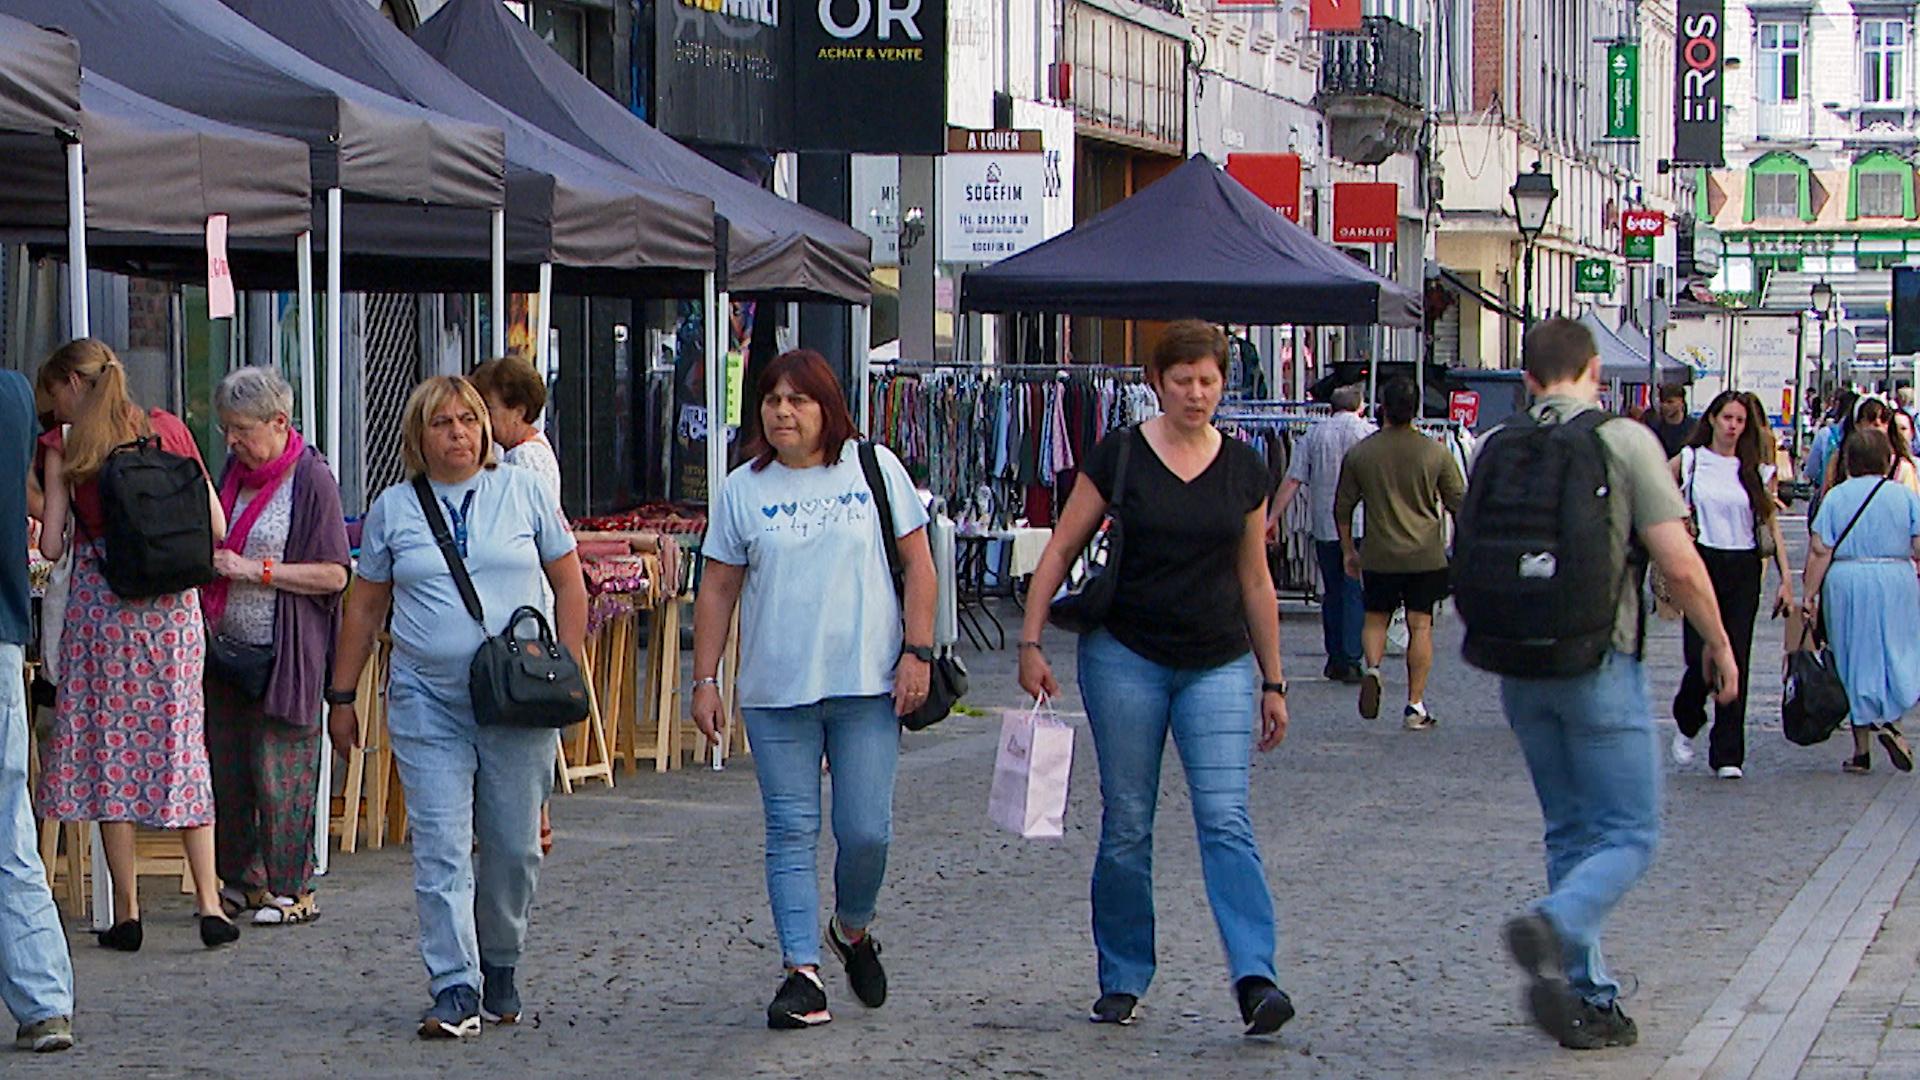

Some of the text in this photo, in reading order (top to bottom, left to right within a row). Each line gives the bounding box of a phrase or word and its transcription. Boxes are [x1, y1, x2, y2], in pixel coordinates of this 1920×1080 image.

[818, 0, 923, 40] OR
[818, 48, 923, 61] ACHAT & VENTE
[1683, 14, 1717, 121] EROS
[980, 132, 1020, 150] LOUER
[966, 185, 1022, 201] SOGEFIM
[1339, 226, 1391, 237] DAMART
